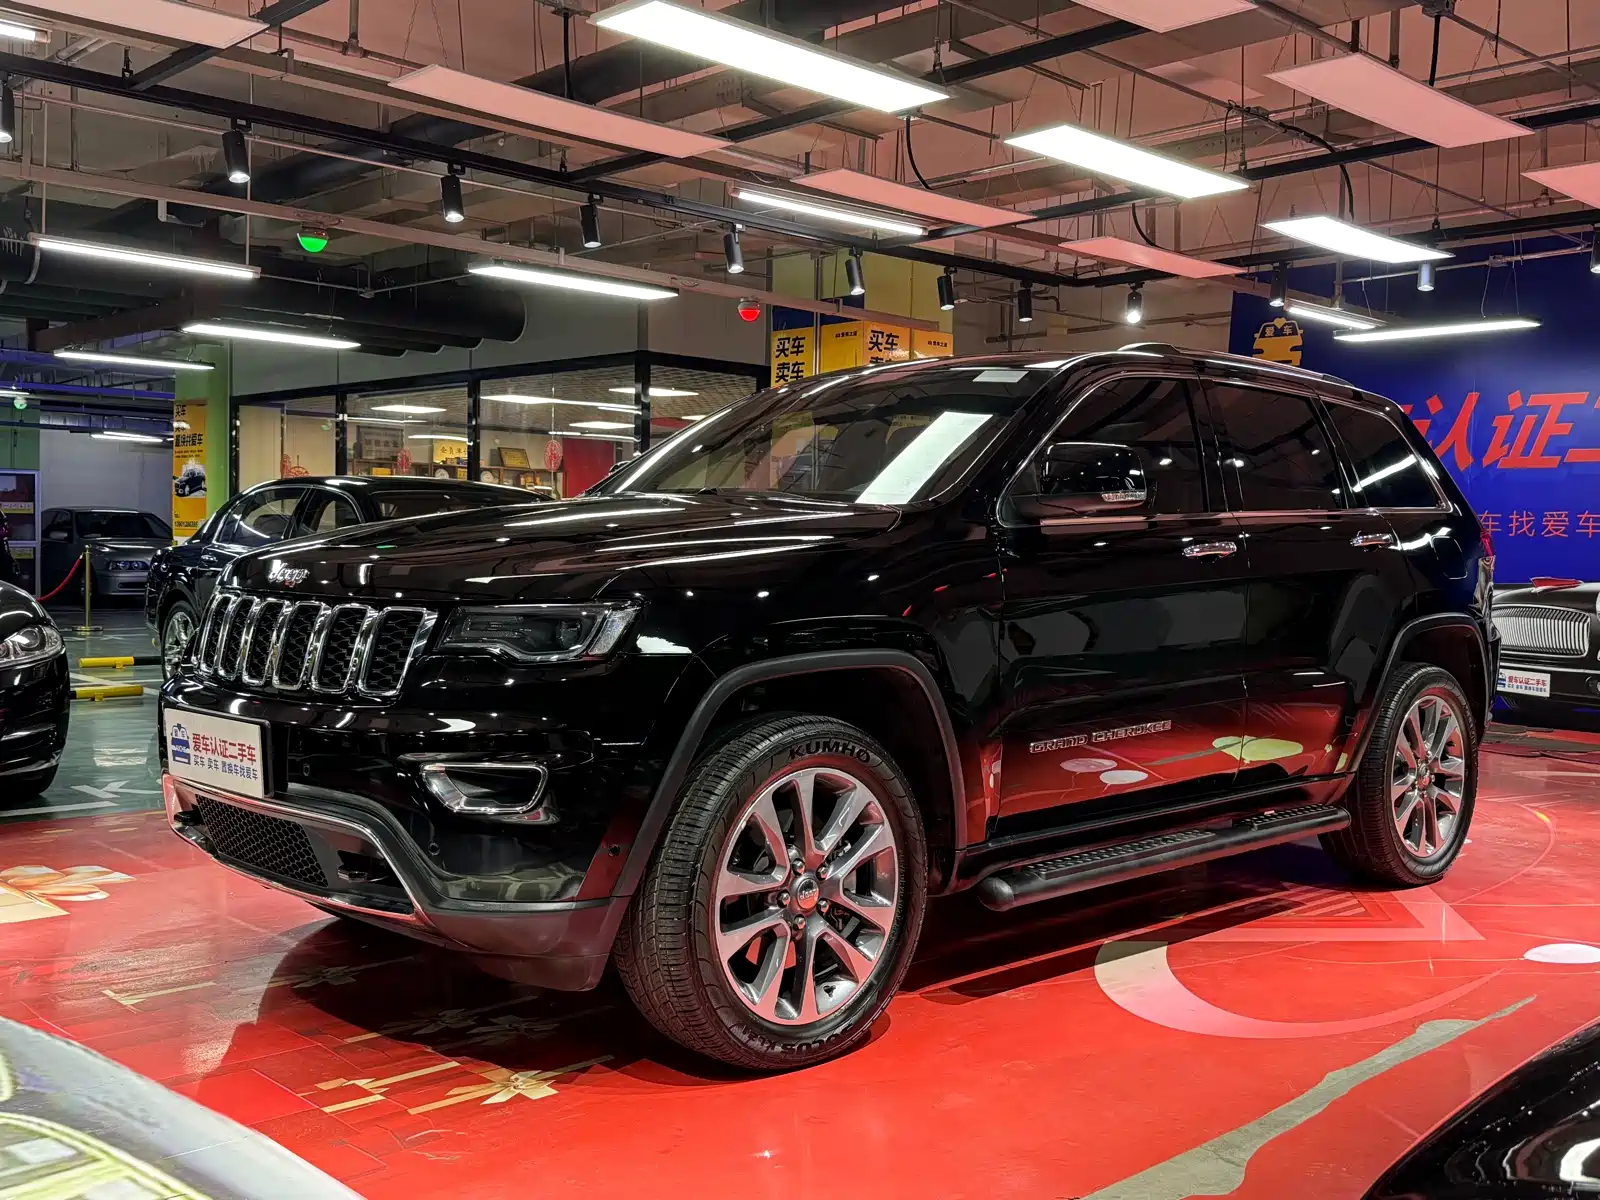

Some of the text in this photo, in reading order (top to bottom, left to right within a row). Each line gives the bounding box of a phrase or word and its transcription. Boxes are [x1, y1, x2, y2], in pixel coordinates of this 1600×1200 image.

[775, 336, 806, 358] 买车
[868, 330, 900, 353] 买车
[775, 361, 806, 383] 卖车
[1401, 390, 1600, 472] 认证
[192, 732, 257, 766] 爱车认证二手车
[1029, 719, 1172, 754] GRAND CHEROKEE
[788, 737, 871, 763] KUMHO
